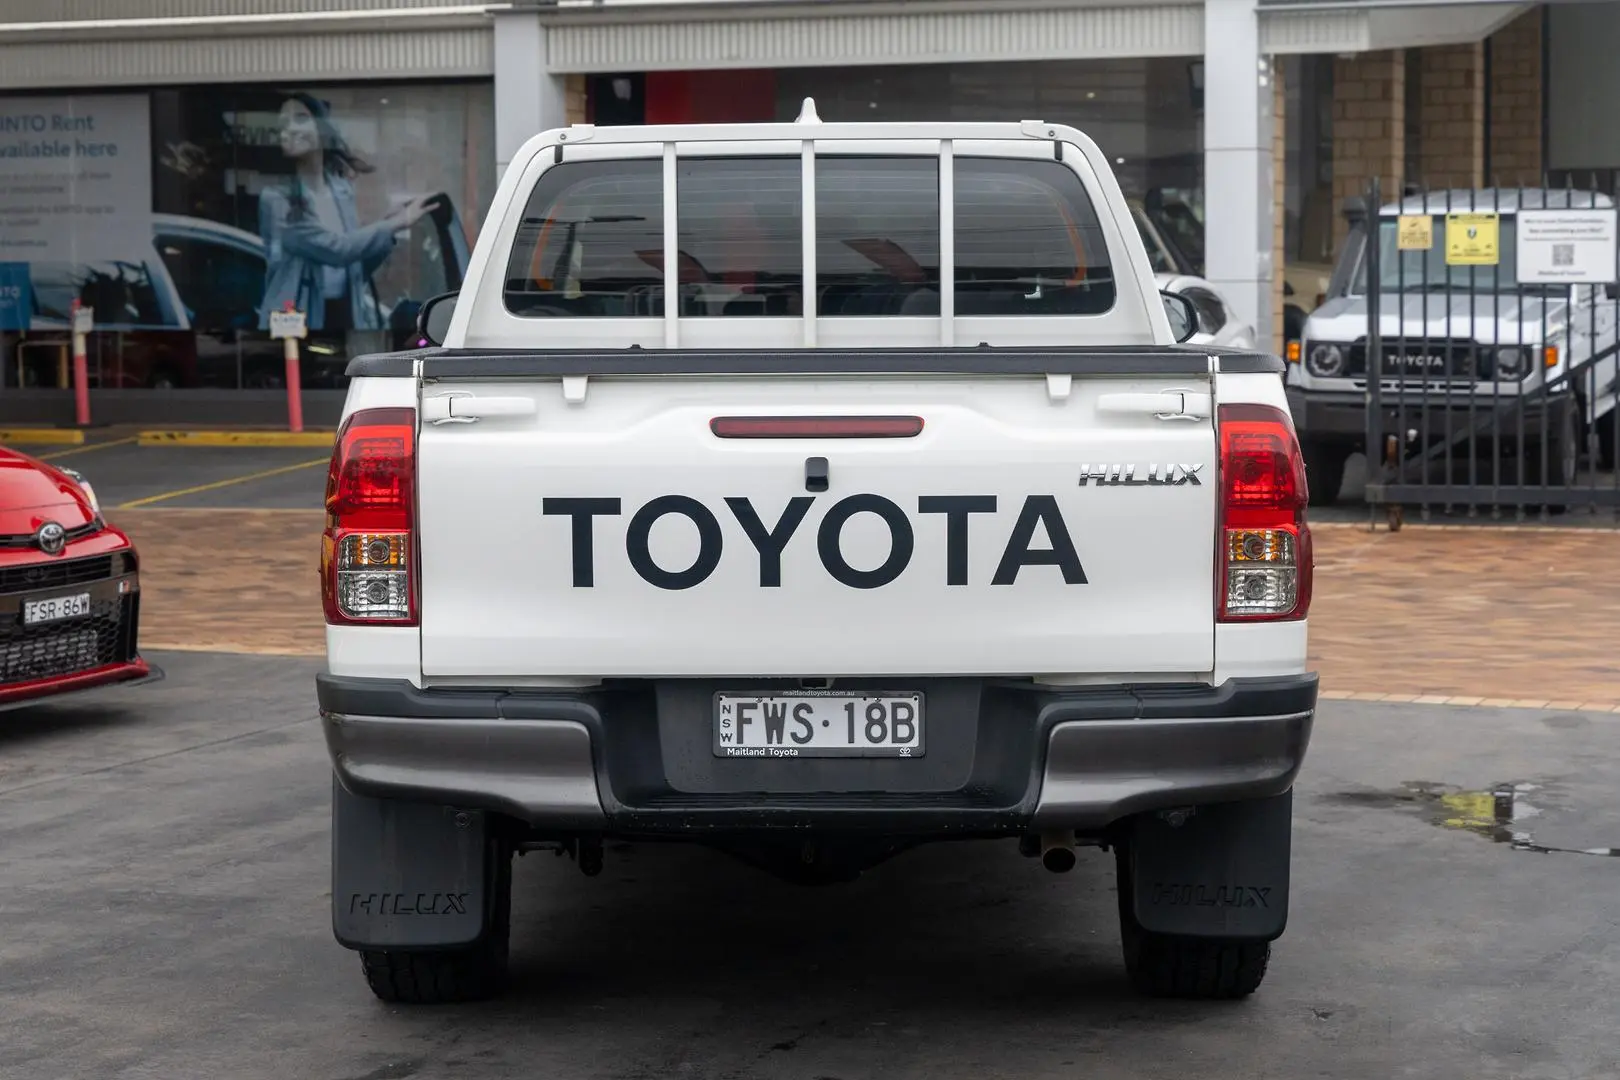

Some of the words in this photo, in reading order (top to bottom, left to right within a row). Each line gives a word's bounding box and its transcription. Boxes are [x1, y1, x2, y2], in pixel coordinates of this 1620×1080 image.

[51, 114, 96, 132] Rent
[75, 138, 118, 158] here
[1078, 463, 1204, 487] HILUX
[543, 493, 1089, 590] TOYOTA
[727, 748, 765, 756] Maitland
[769, 748, 799, 757] Toyota
[350, 893, 470, 915] HILUX
